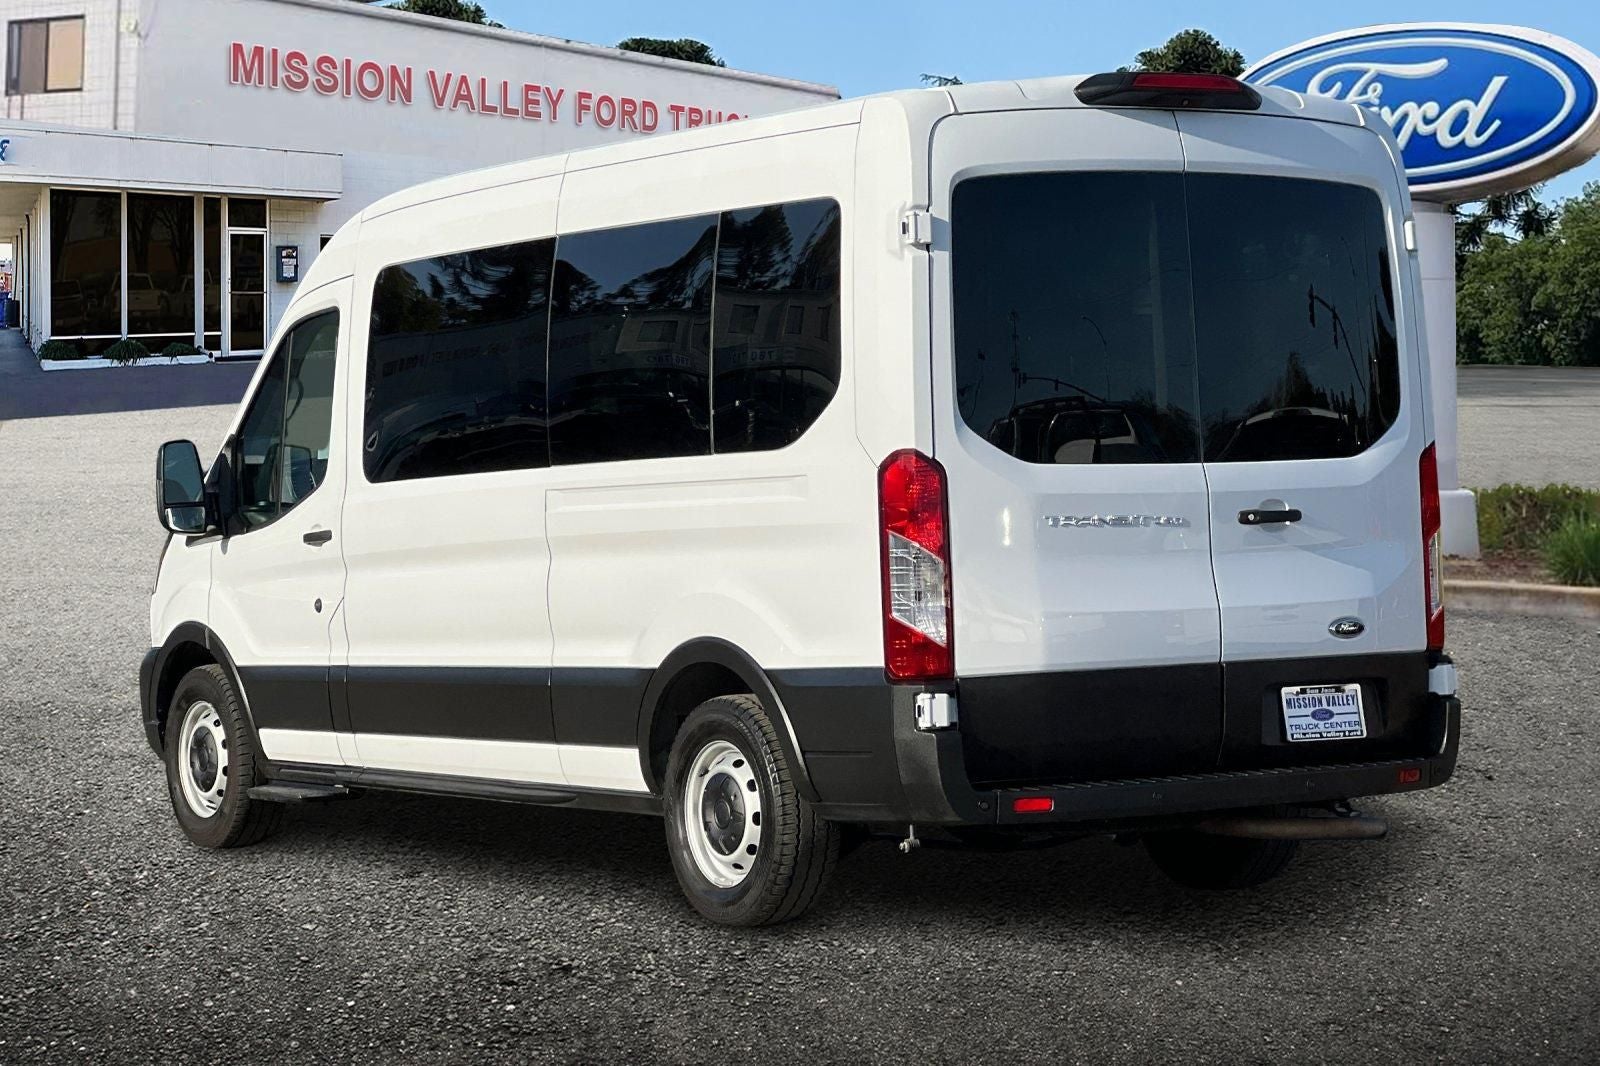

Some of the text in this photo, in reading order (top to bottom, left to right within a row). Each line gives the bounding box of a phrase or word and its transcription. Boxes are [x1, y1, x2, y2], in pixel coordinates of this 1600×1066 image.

[230, 41, 413, 105] MISSION
[427, 69, 565, 122] VALLEY
[575, 89, 659, 134] FORD
[1286, 694, 1356, 710] MISSION VALLEY
[1290, 720, 1360, 732] TRUCK CENTER
[1322, 730, 1344, 738] Valley
